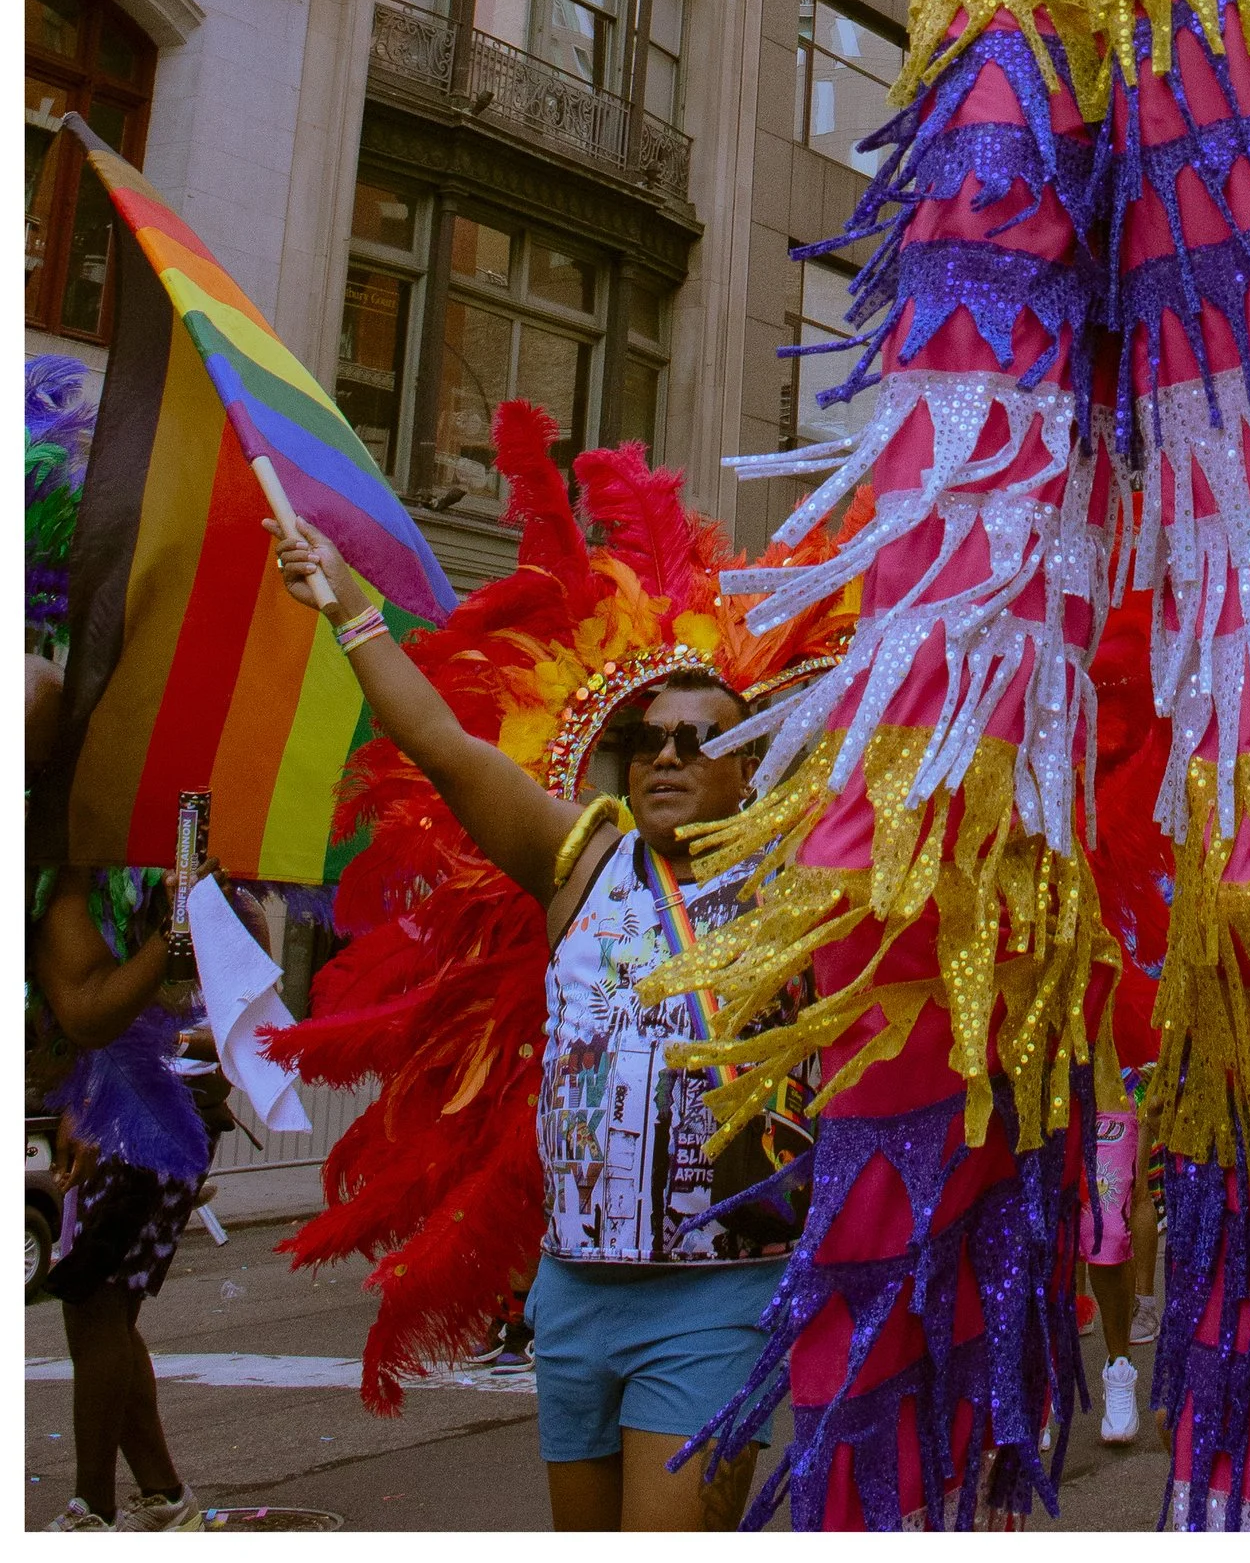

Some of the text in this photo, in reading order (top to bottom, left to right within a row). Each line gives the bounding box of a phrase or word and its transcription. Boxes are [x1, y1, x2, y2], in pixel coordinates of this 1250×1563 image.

[175, 818, 192, 924] CONFETTI CANNON
[613, 1085, 629, 1123] BRONX
[678, 1132, 711, 1145] BEW
[674, 1167, 715, 1183] ARTIS
